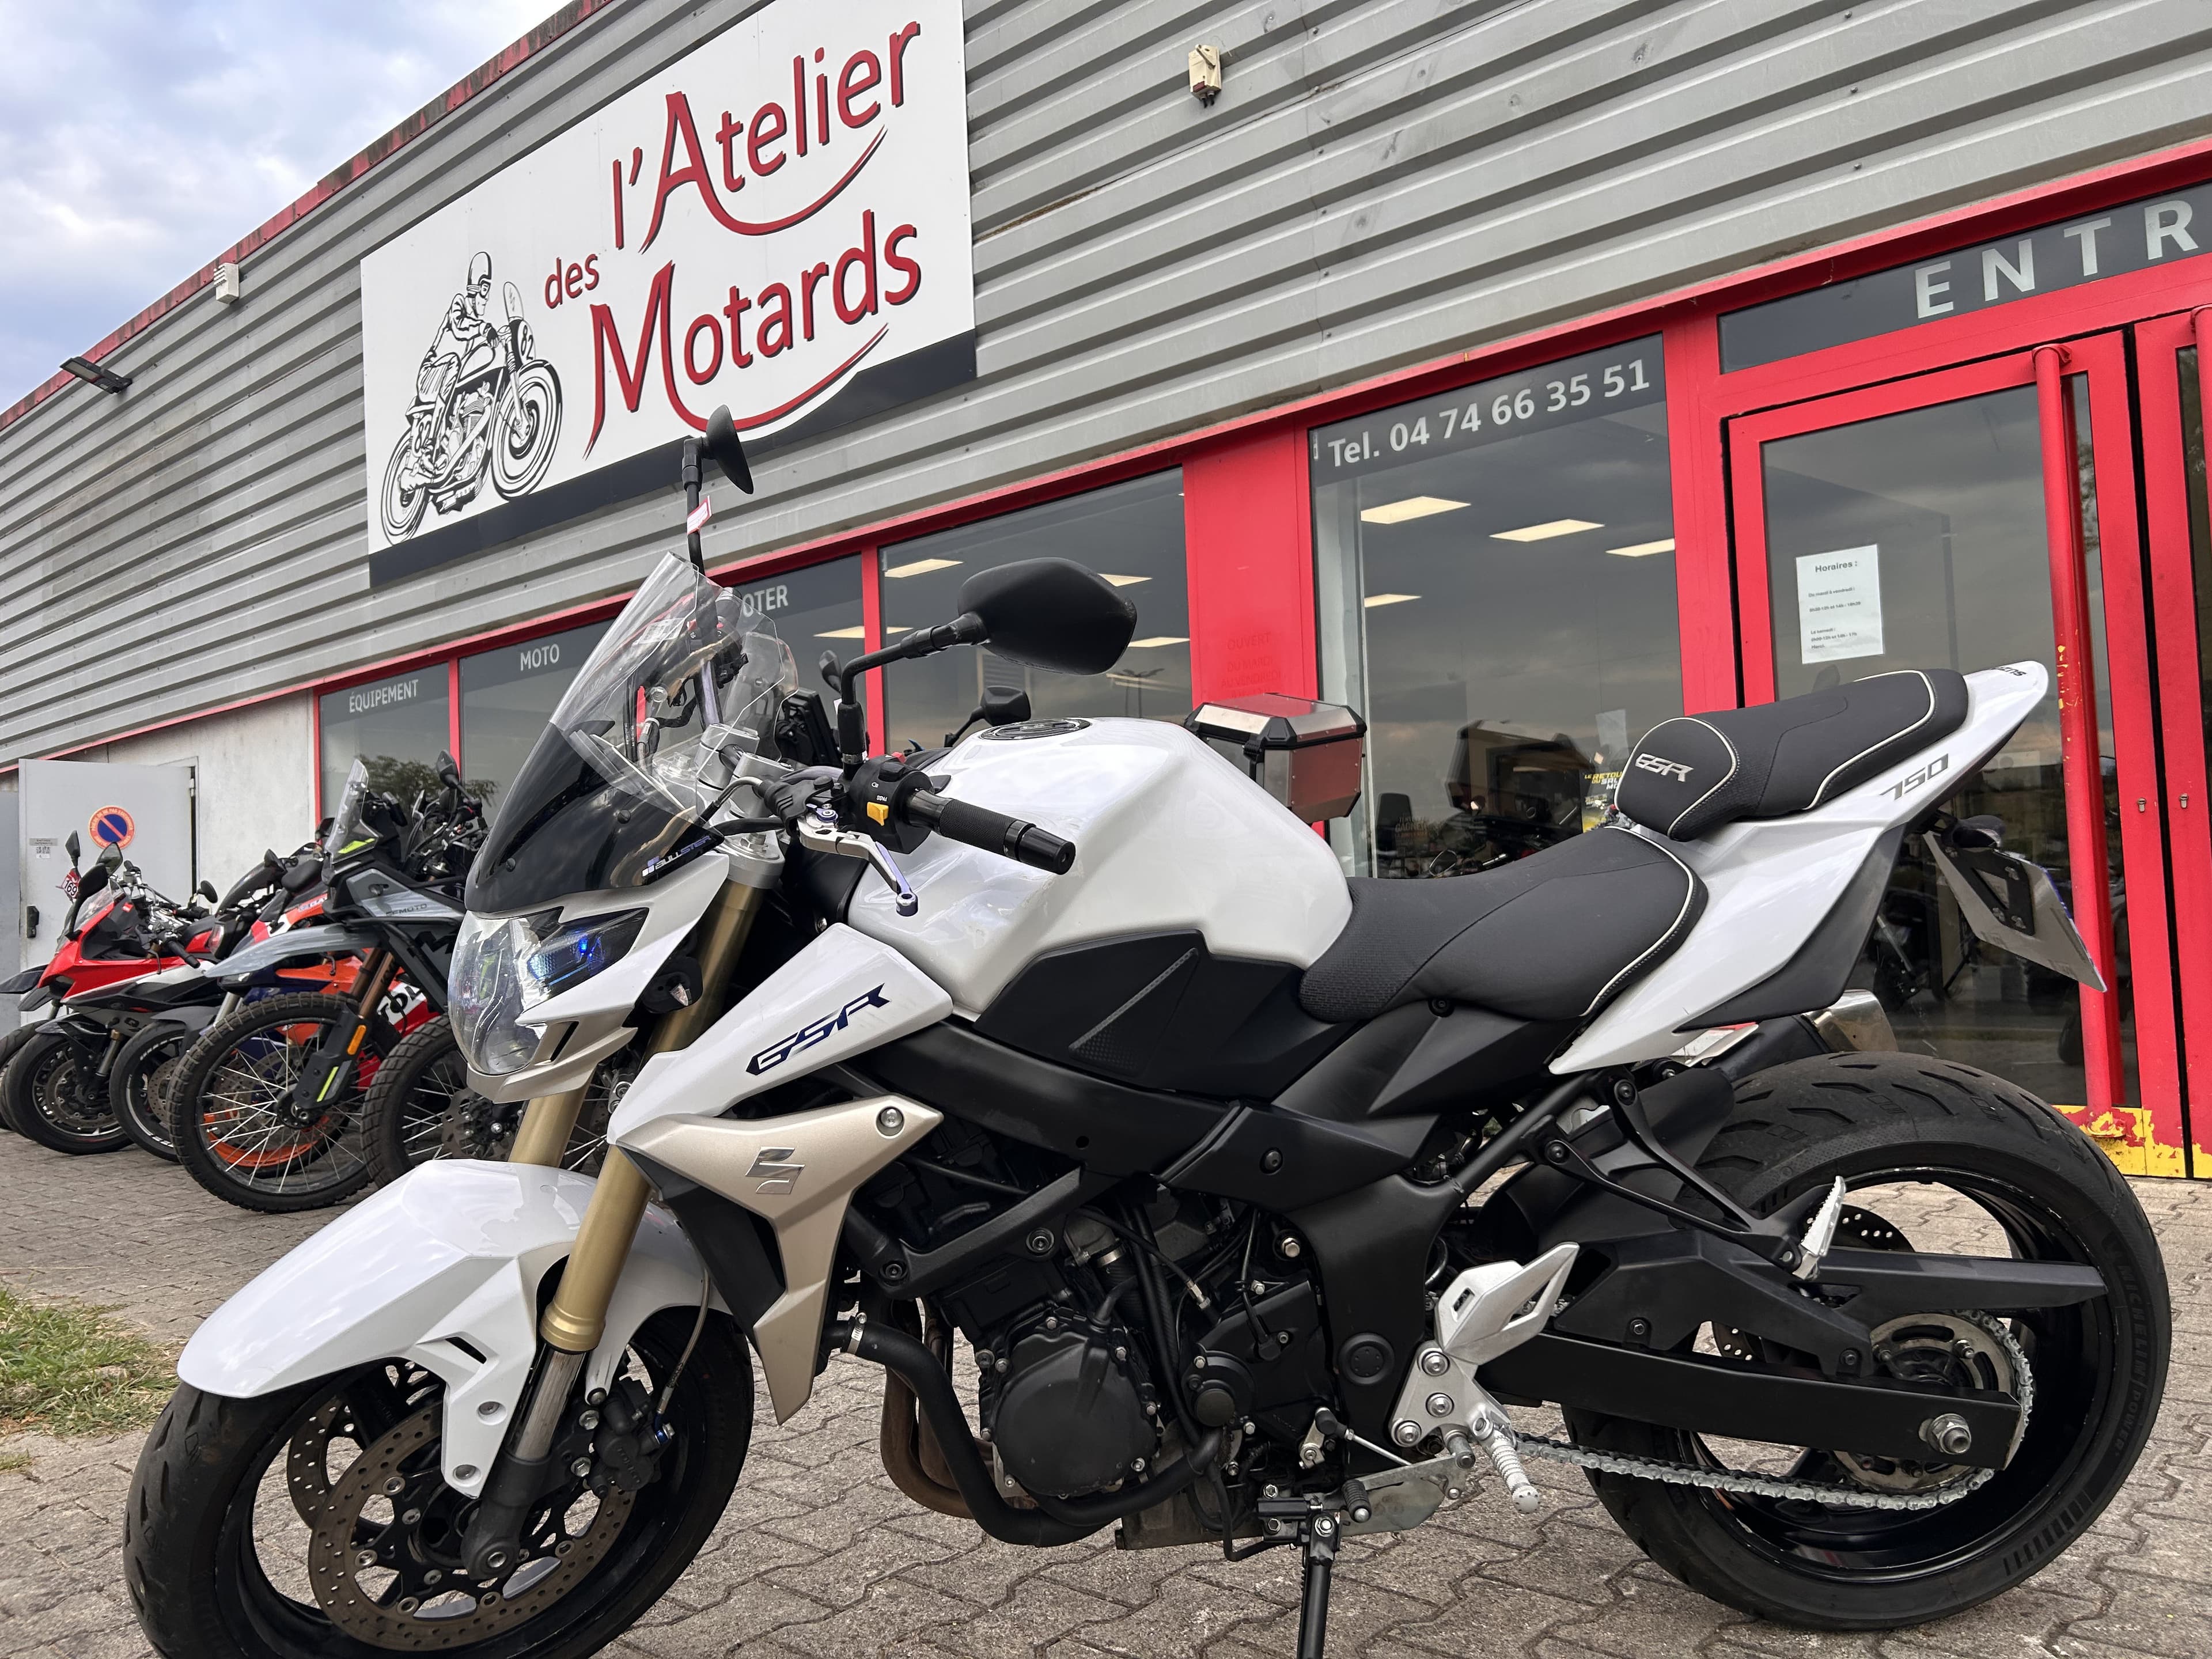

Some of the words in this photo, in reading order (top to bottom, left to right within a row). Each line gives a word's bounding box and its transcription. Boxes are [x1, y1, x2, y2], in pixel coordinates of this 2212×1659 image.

[612, 20, 921, 255] l'Atelier
[544, 252, 600, 310] des
[1914, 199, 2199, 319] ENTR
[583, 209, 922, 460] Motards
[1327, 431, 1380, 468] Tel.
[1389, 416, 1430, 453] 04
[1438, 403, 1482, 440] 74
[1491, 388, 1535, 425] 66
[1546, 373, 1591, 413] 35
[1602, 359, 1650, 398] 51
[1815, 562, 1853, 573] Horaires
[520, 643, 560, 672] MOTO
[349, 679, 419, 714] ÉQUIPEMENT
[1634, 752, 1695, 783] GSR
[1878, 752, 1950, 801] 750
[655, 835, 711, 870] BULLSTER
[64, 880, 77, 896] 169
[745, 982, 892, 1076] GSR
[2115, 1265, 2147, 1378] MICHELIN
[2115, 1390, 2142, 1448] POWER
